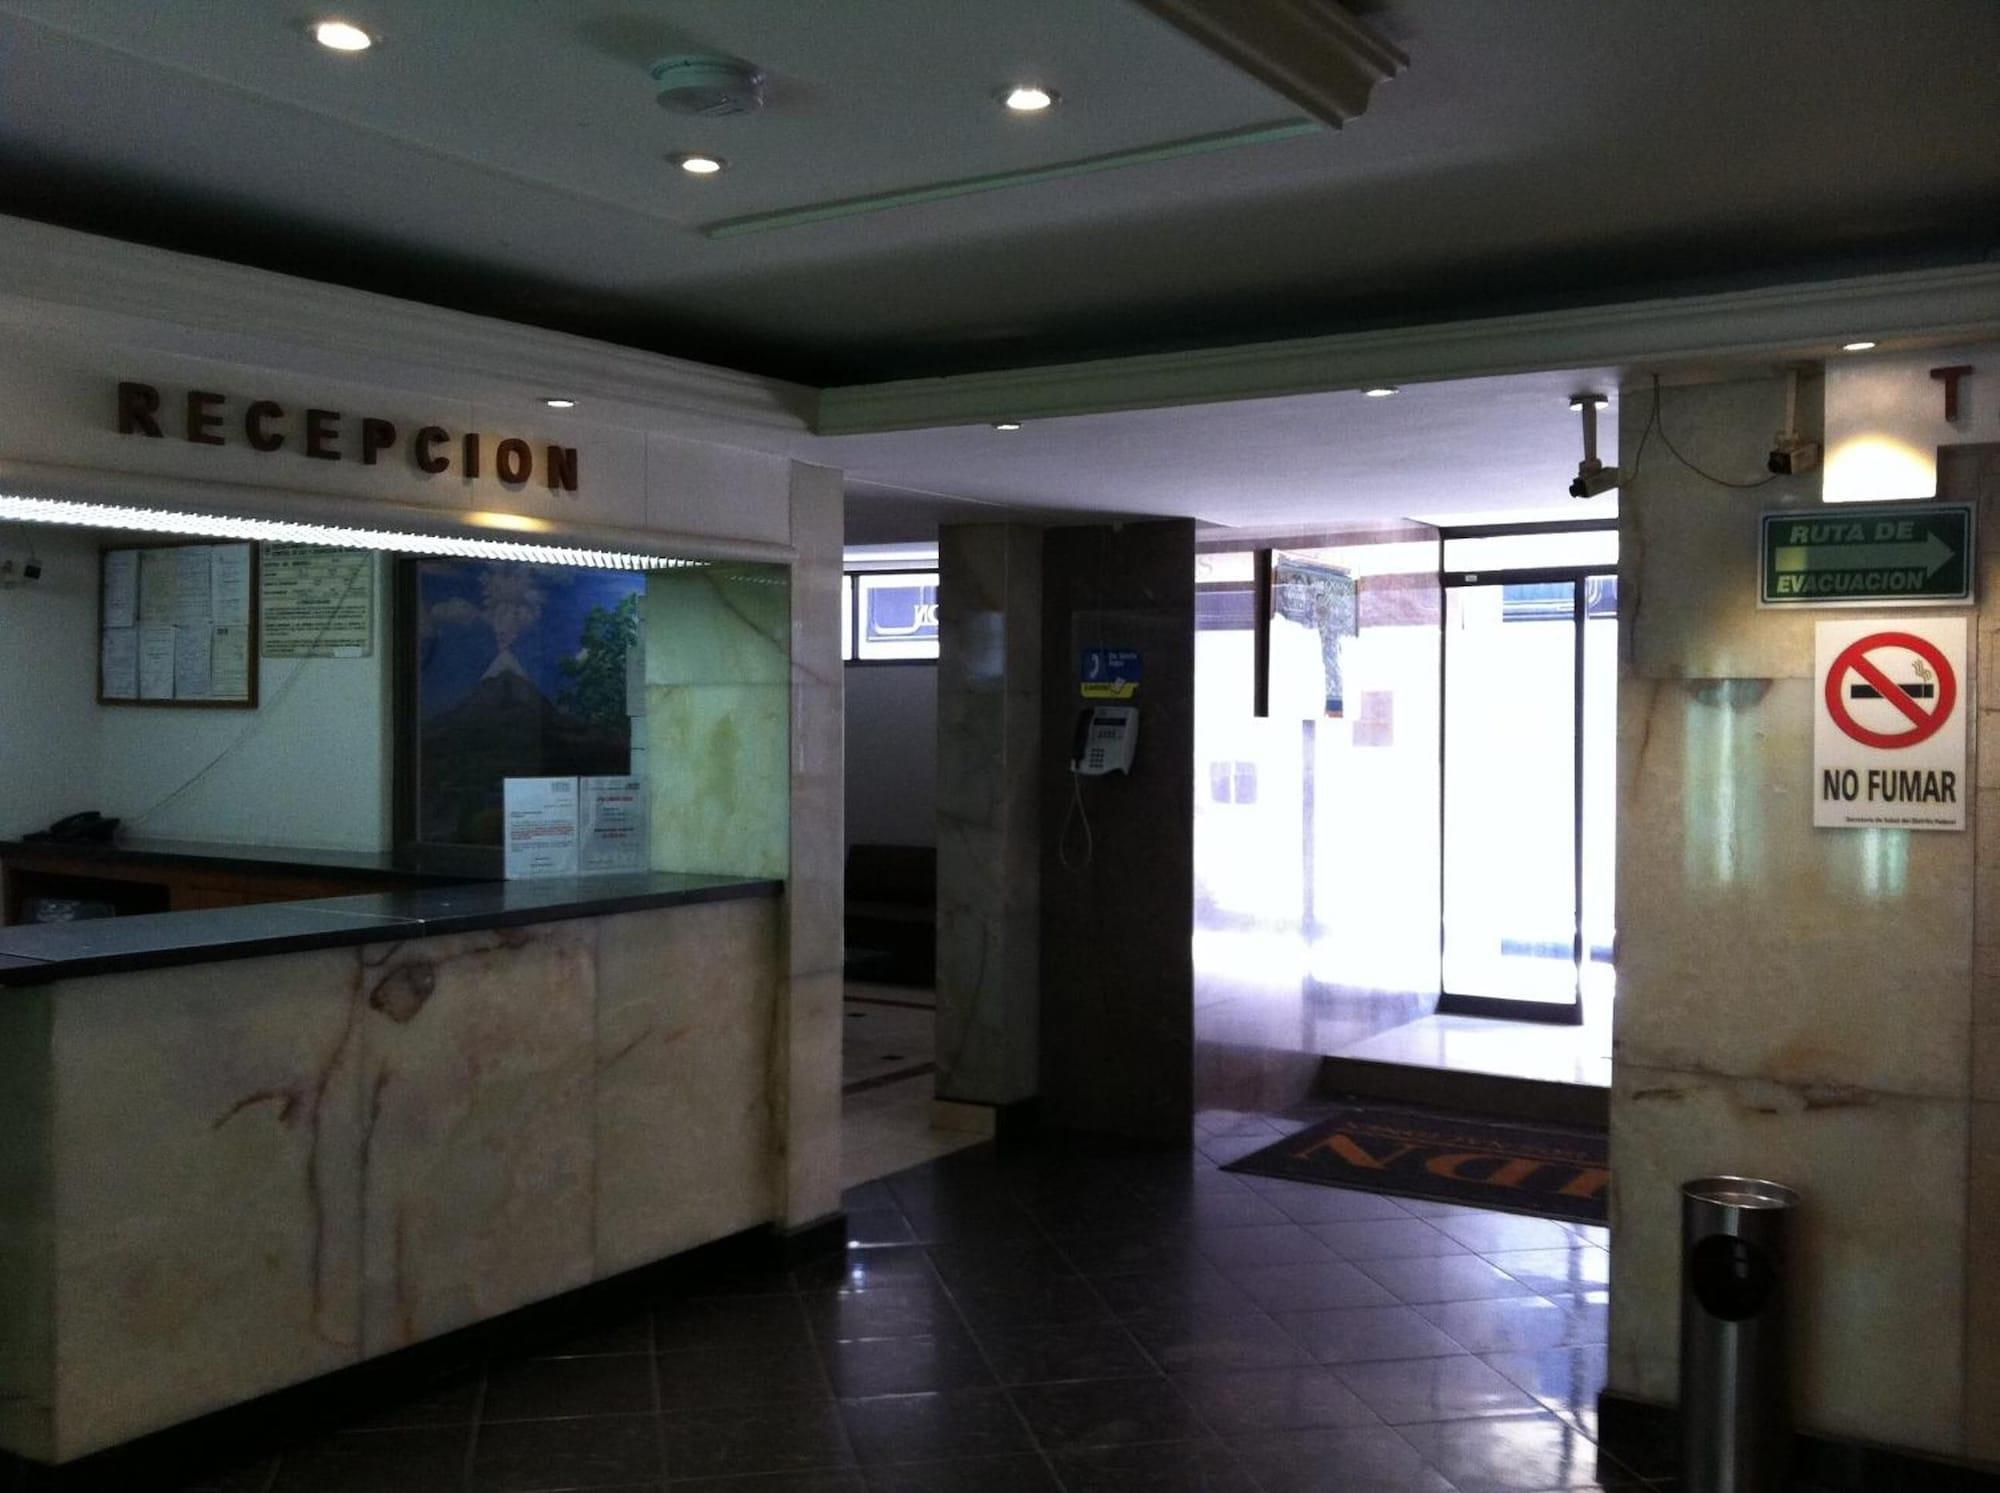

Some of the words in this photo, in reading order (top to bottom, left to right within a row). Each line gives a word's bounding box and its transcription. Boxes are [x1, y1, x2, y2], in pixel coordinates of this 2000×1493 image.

[118, 381, 578, 491] RECEPCION
[1790, 524, 1865, 545] RUTA
[1875, 521, 1915, 541] DE
[1777, 571, 1924, 594] EVACUACION
[1824, 769, 1859, 801] NO
[1868, 769, 1957, 803] FUMAR
